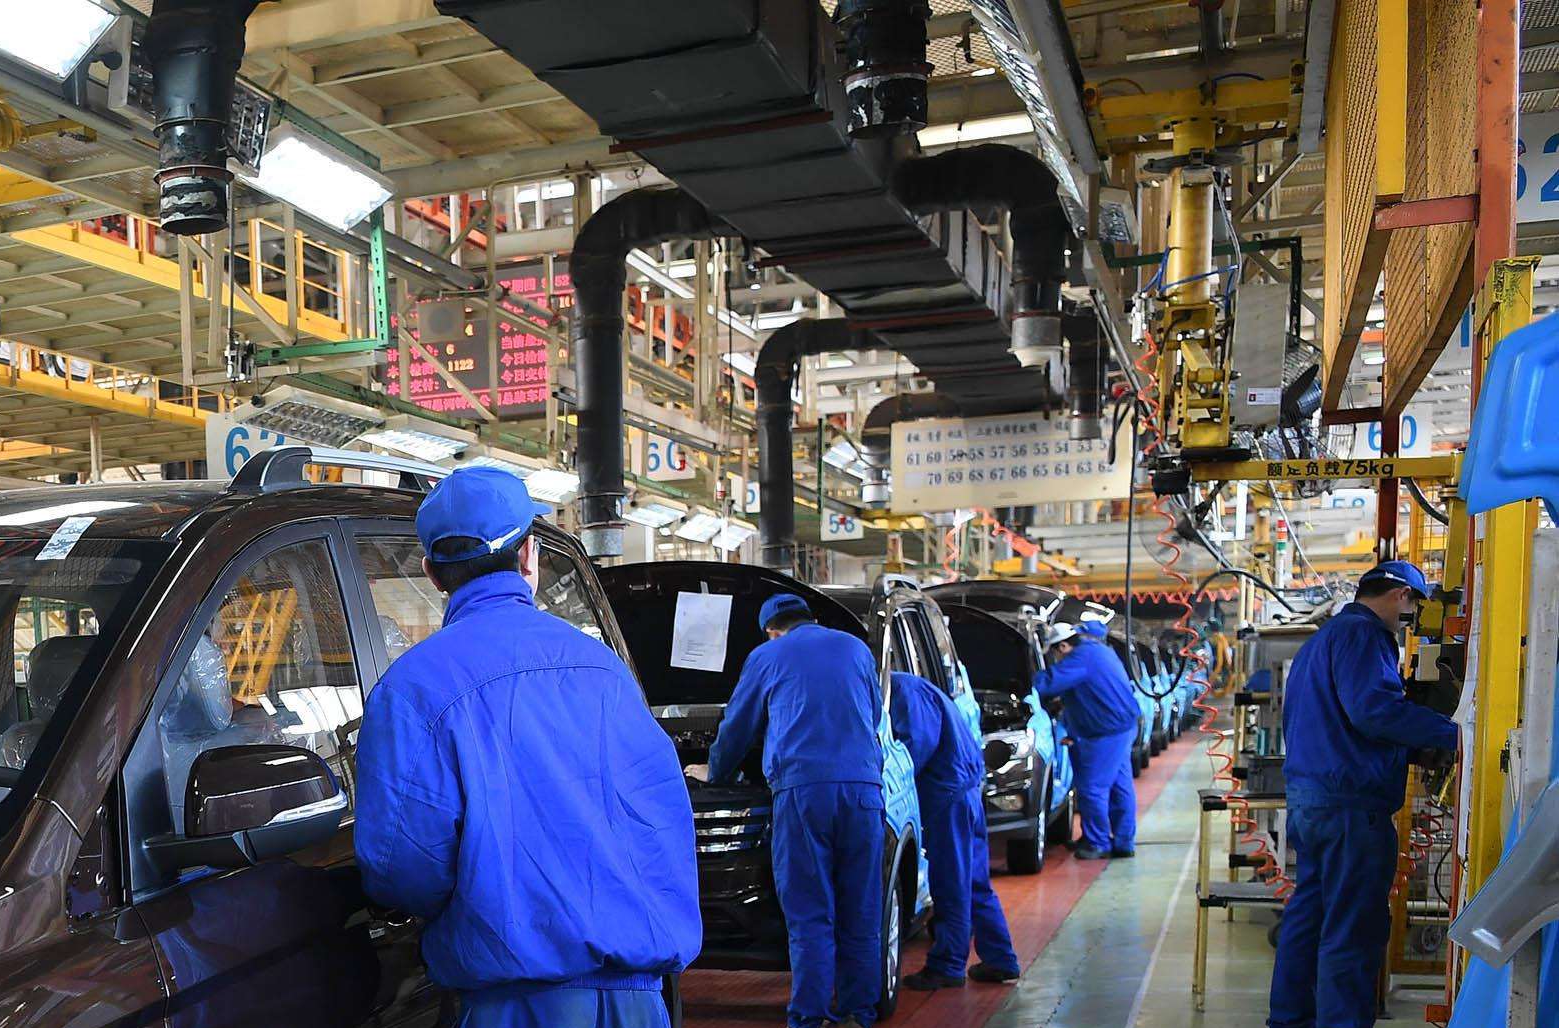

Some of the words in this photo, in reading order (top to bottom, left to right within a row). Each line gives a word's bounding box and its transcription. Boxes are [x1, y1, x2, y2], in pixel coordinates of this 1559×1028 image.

[1368, 415, 1417, 451] 60
[907, 453, 920, 465] 61
[927, 451, 942, 463] 60
[991, 446, 1006, 459] 57
[1011, 444, 1027, 458] 56
[1033, 442, 1049, 456] 55
[927, 472, 942, 484] 70
[948, 471, 963, 484] 69
[969, 469, 984, 482] 68
[990, 467, 1006, 481] 67
[1011, 465, 1027, 479] 66
[1033, 464, 1048, 477] 65
[1077, 461, 1092, 474] 63
